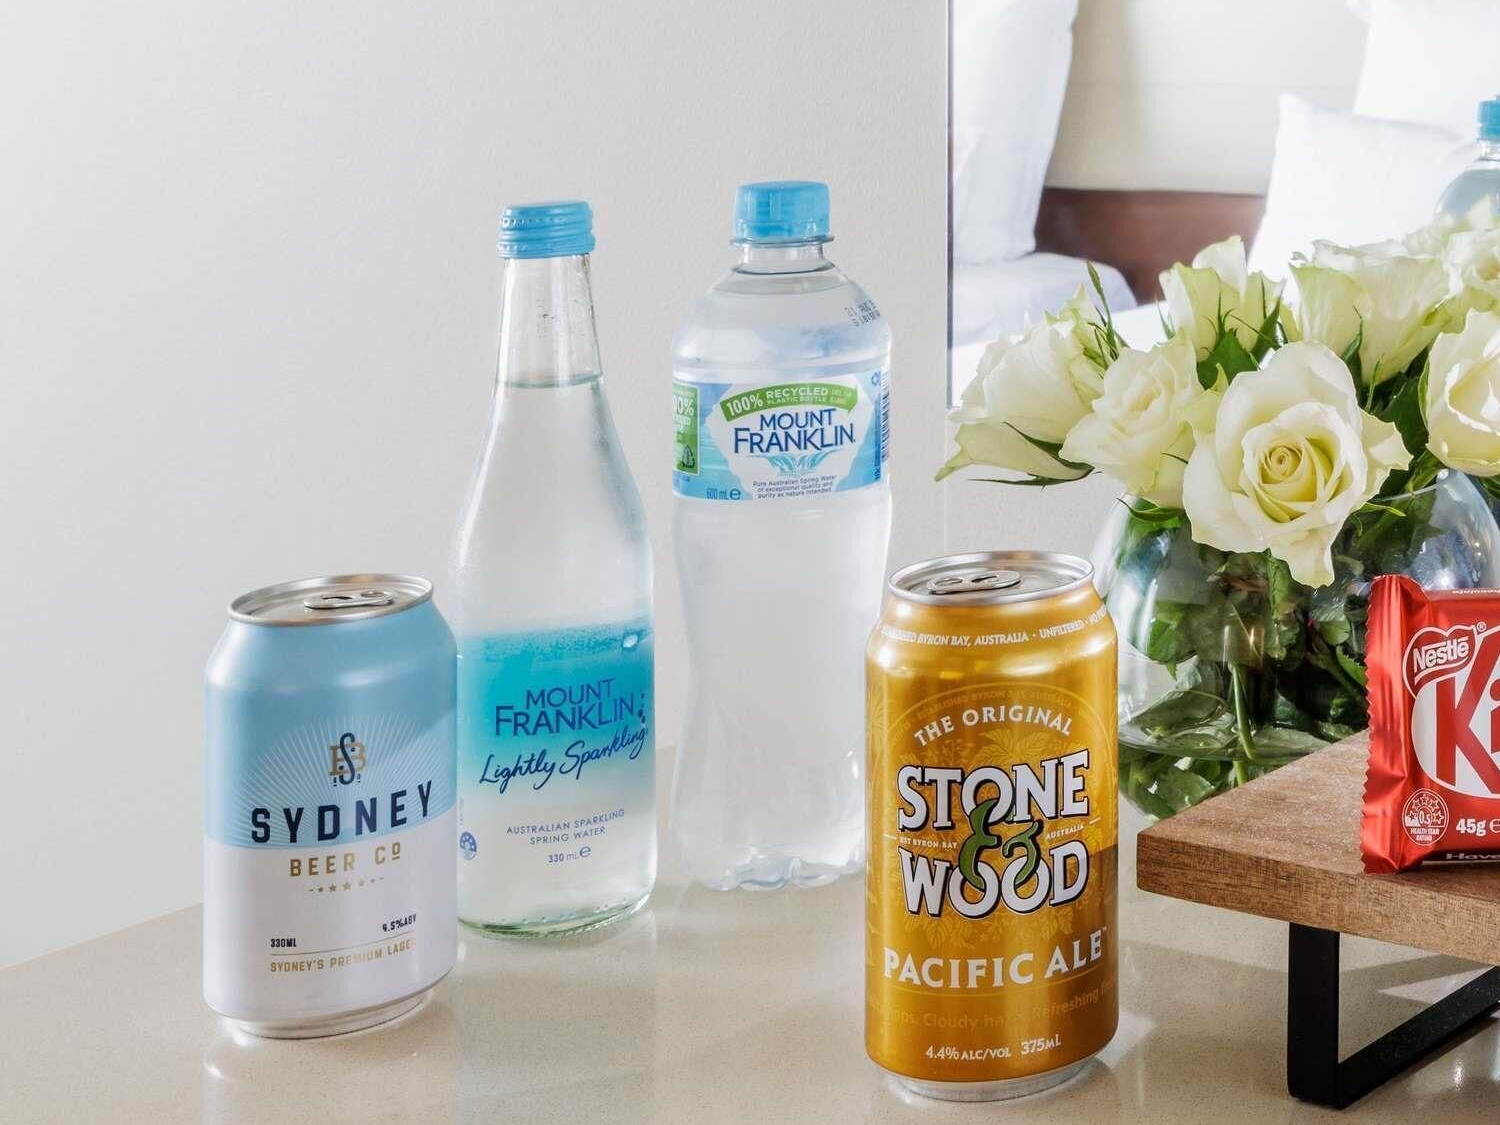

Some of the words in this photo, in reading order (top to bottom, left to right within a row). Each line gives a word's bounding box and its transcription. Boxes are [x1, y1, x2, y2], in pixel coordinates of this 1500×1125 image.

[726, 393, 763, 416] 100%
[766, 387, 828, 399] RECYCLED
[760, 408, 836, 431] MOUNT
[734, 423, 854, 453] FRANKLIN
[918, 633, 949, 645] BYRON
[974, 632, 1029, 645] AUSTRALIA
[1039, 619, 1086, 640] UNFILTERED
[526, 678, 616, 709] MOUNT
[495, 692, 634, 736] FRANKLIN
[914, 715, 955, 747] THE
[962, 705, 1073, 737] ORIGINAL
[480, 749, 556, 794] Lightly
[559, 725, 648, 780] Sparkling
[897, 748, 1090, 832] STONE
[251, 780, 432, 844] SYDNEY
[506, 821, 570, 835] AUSTRALIAN
[574, 809, 625, 829] SPARKLING
[1418, 811, 1431, 825] 0.5
[529, 834, 569, 845] SPRING
[573, 826, 606, 840] WATER
[1046, 823, 1085, 840] AUSTRALIA
[1456, 819, 1487, 836] 45g
[913, 838, 939, 848] BYRON
[942, 841, 957, 849] BAY
[290, 853, 356, 877] BEER
[548, 852, 564, 863] 330
[898, 840, 1089, 918] WOOD
[270, 938, 297, 948] 330ML
[270, 959, 324, 973] SYDNEY'S
[330, 948, 383, 969] PREMIUM
[884, 946, 1034, 988] PACIFIC
[1045, 930, 1103, 978] ALE
[1032, 987, 1101, 1020] Refreshing
[923, 1013, 978, 1030] Cloudy
[926, 1045, 959, 1061] 4.4%
[961, 1047, 1012, 1061] ALC/VOL
